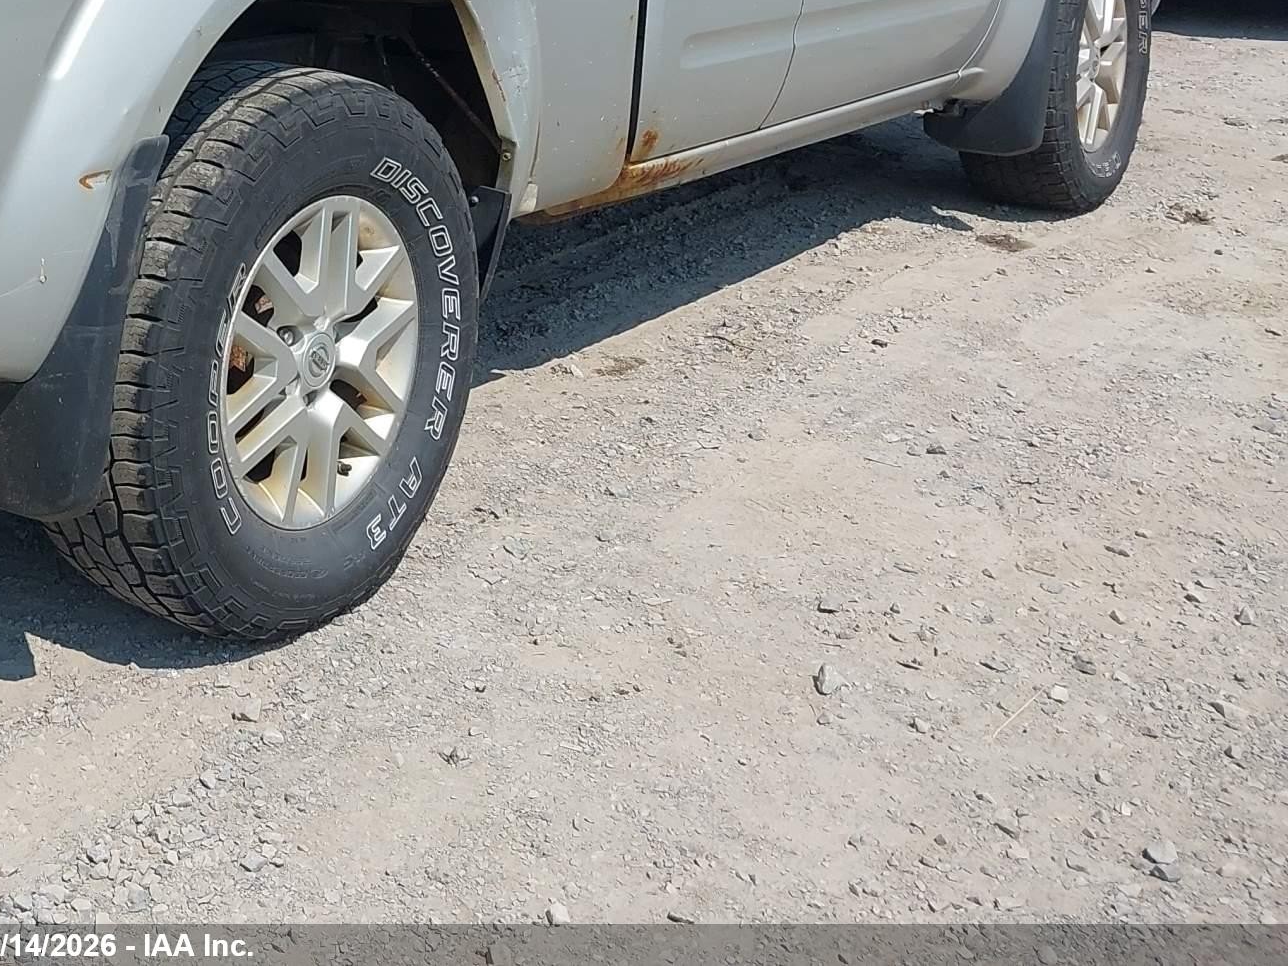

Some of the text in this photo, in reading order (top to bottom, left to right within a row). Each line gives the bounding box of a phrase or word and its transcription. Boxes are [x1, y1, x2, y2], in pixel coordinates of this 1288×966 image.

[208, 262, 247, 535] COOPER
[366, 156, 460, 550] DISCOVERER AT3
